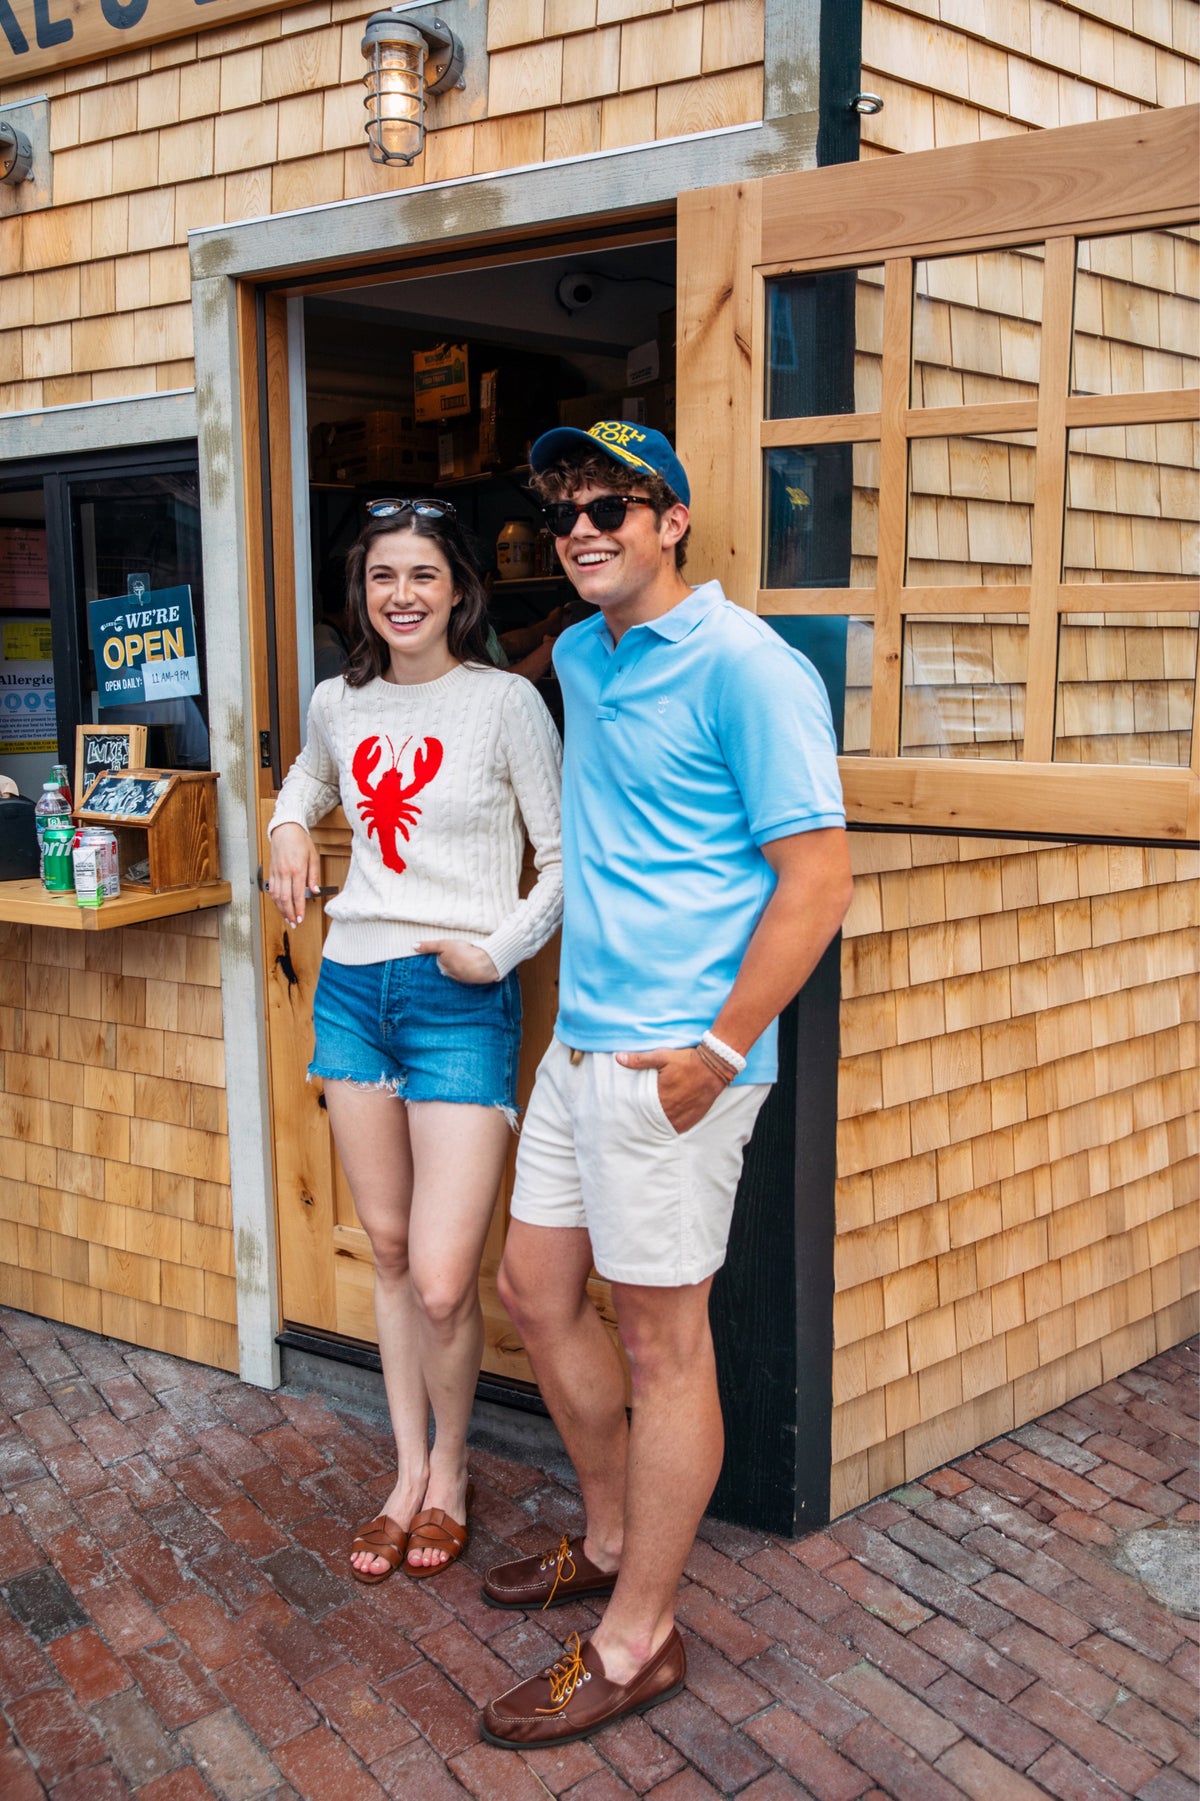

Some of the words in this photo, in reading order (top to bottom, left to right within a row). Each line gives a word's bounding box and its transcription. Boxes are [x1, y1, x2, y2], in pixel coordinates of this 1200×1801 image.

[125, 606, 180, 629] WE'RE
[103, 627, 185, 670] OPEN
[105, 681, 121, 692] OPEN
[122, 677, 143, 690] DAILY:
[152, 672, 160, 684] 11
[180, 669, 190, 681] PM
